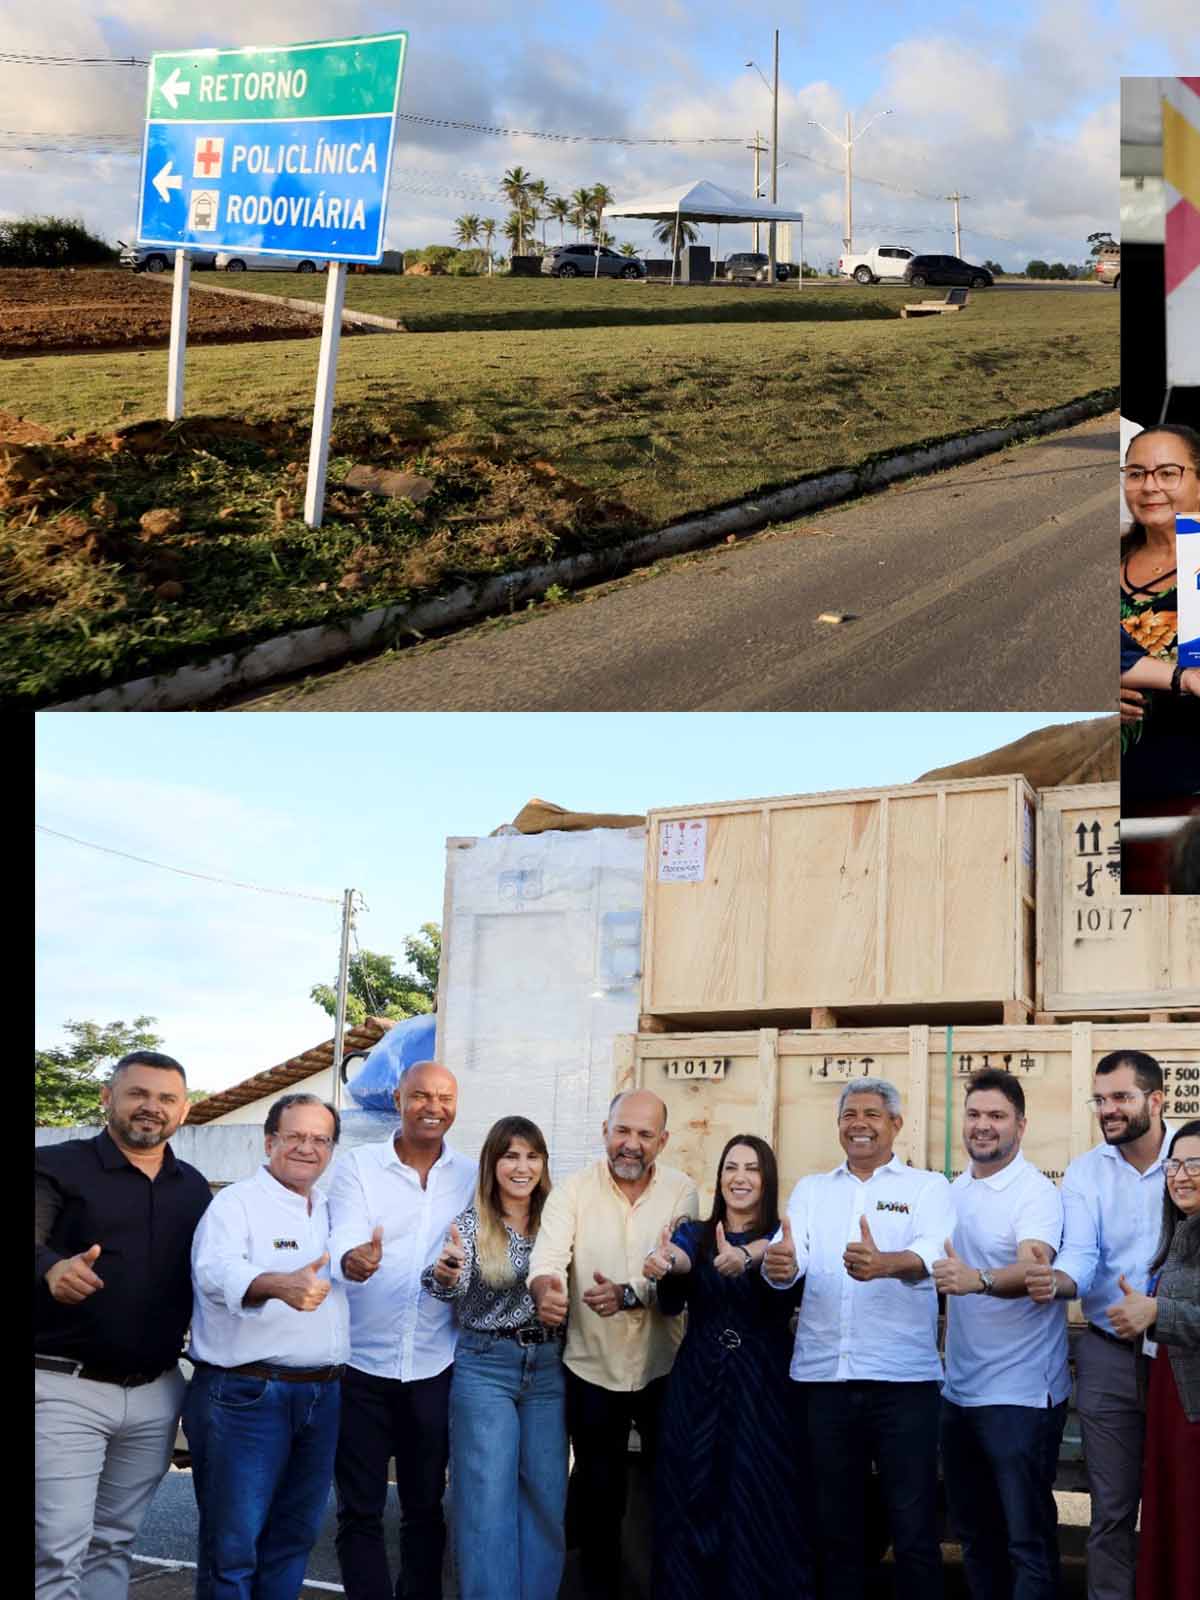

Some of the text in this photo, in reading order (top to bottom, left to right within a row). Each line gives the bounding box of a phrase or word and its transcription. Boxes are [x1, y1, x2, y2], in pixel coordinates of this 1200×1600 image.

[199, 69, 308, 102] RETORNO
[231, 137, 378, 175] POLICLÍNICA
[226, 191, 366, 231] RODOVIÁRIA
[1077, 908, 1132, 931] 1017
[671, 1060, 722, 1075] 1017
[1175, 1068, 1200, 1081] 500
[1174, 1085, 1200, 1097] 630
[1174, 1102, 1199, 1114] 800
